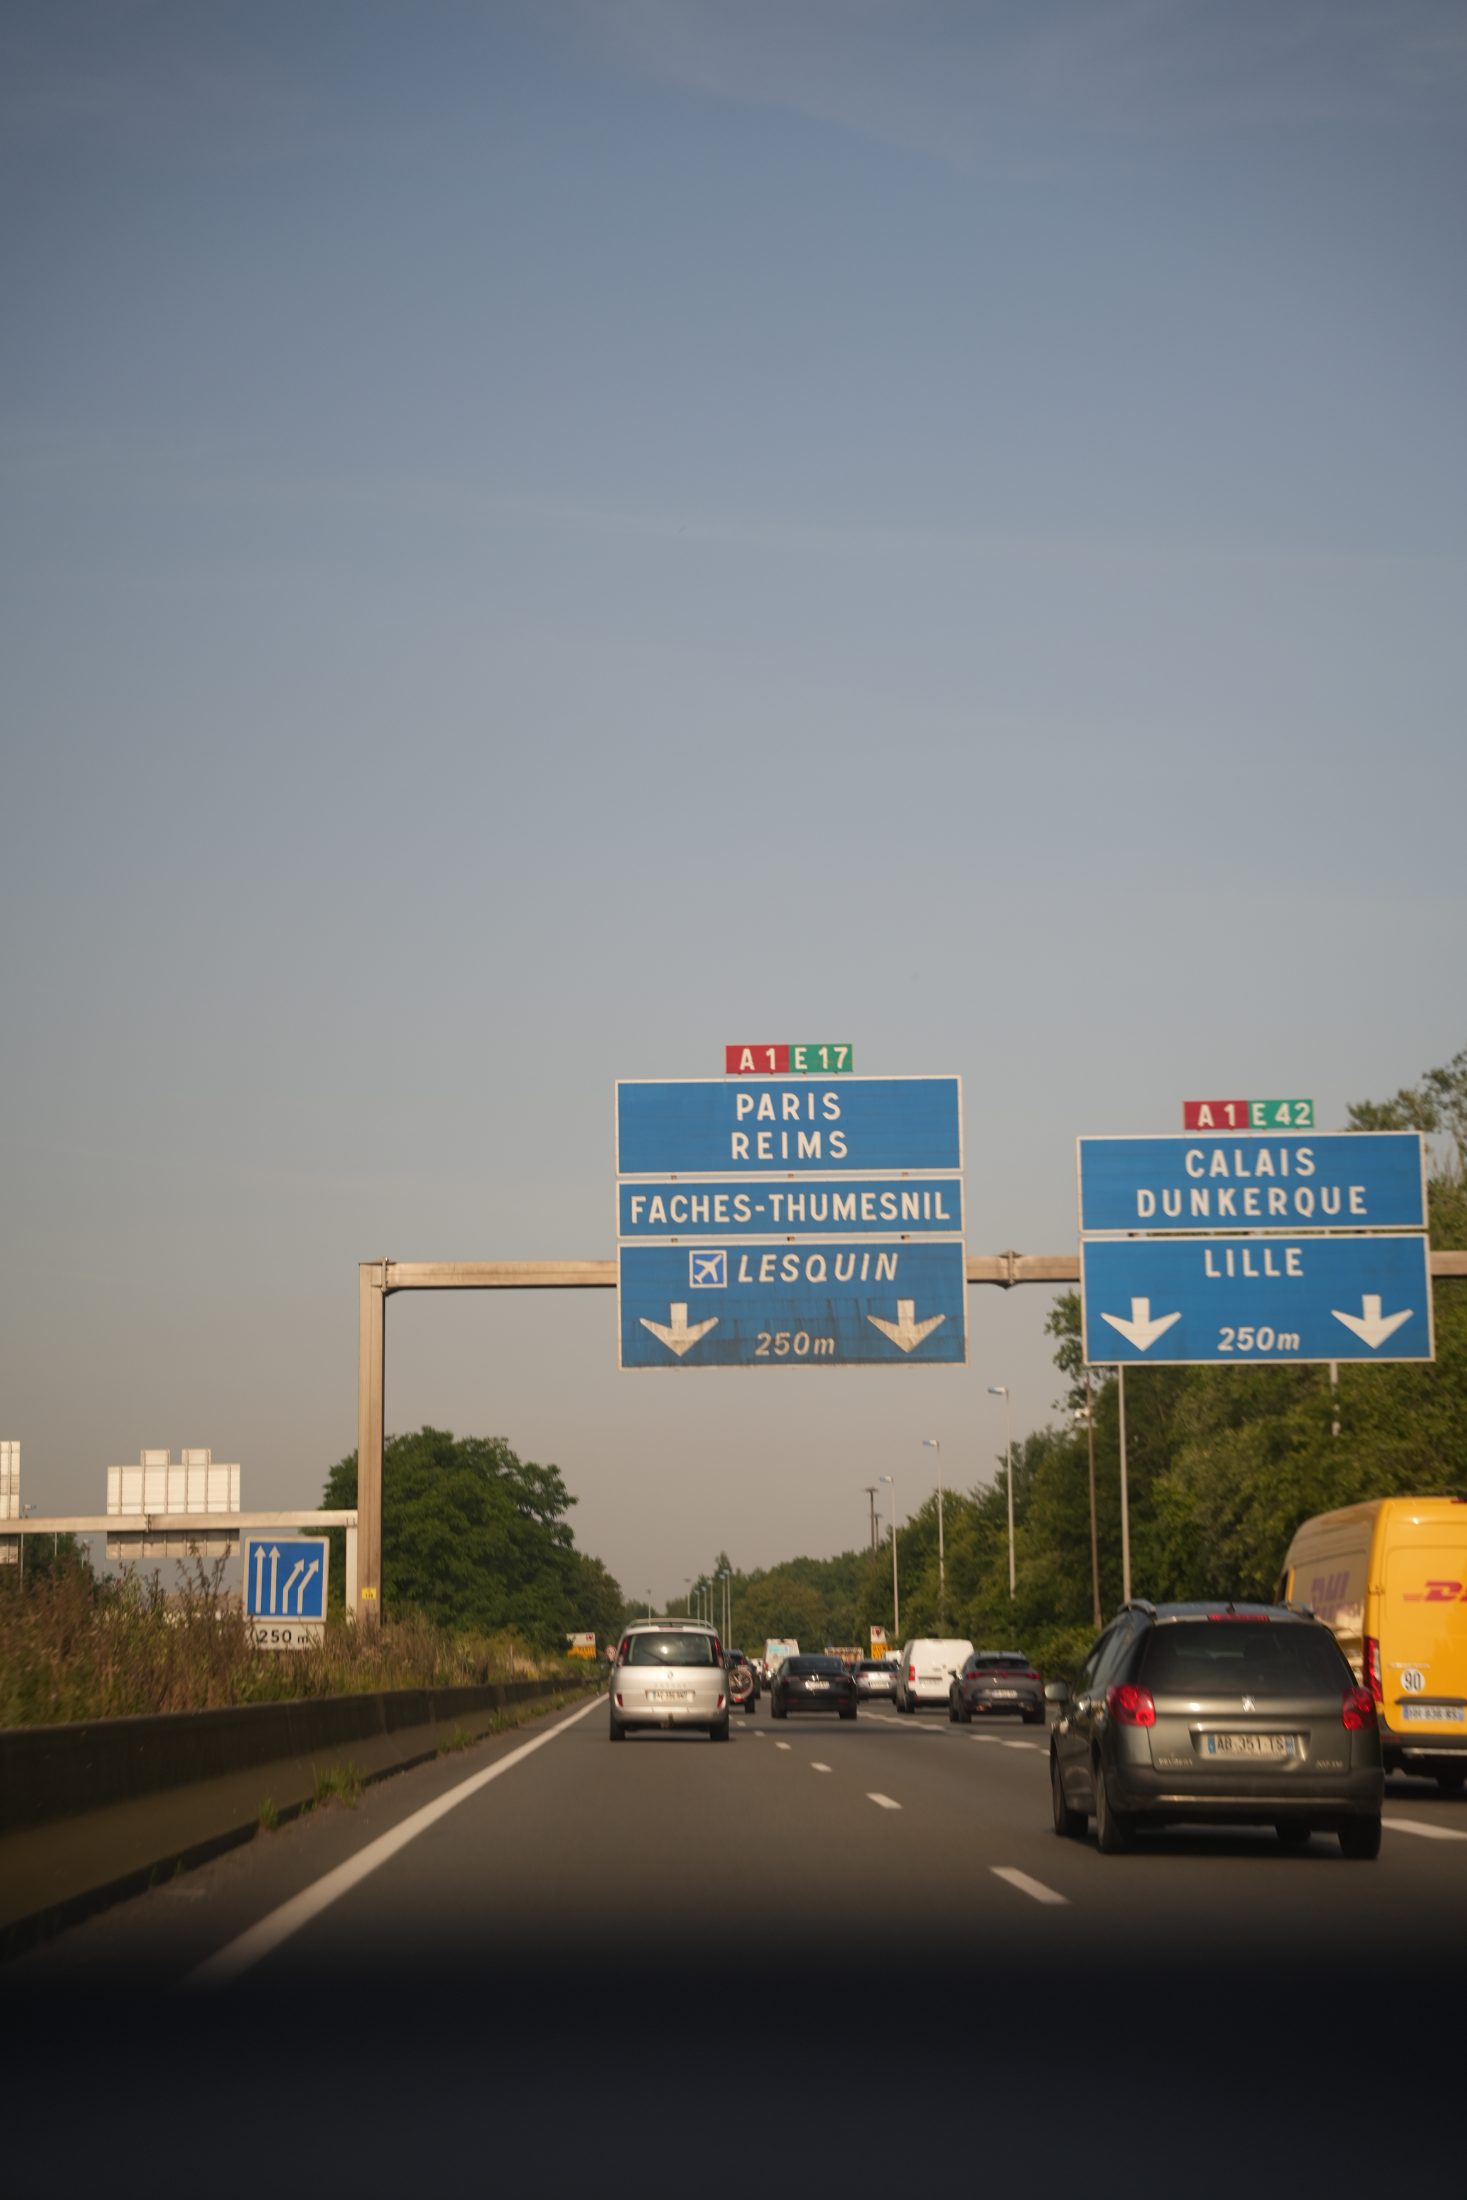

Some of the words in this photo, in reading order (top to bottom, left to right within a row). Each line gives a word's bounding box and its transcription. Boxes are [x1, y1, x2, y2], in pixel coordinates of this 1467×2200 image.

[795, 1048, 807, 1069] E
[819, 1047, 848, 1069] 17
[736, 1092, 841, 1121] PARIS
[1252, 1103, 1266, 1125] E
[1275, 1102, 1311, 1125] 42
[731, 1131, 848, 1160] REIMS
[1185, 1148, 1315, 1178] CALAIS
[631, 1192, 950, 1224] FACHES-THUMESNIL
[1137, 1186, 1367, 1218] DUNKERQUE
[738, 1253, 898, 1283] LESQUIN
[1204, 1248, 1304, 1278] LILLE
[755, 1332, 835, 1356] 250m
[1217, 1326, 1300, 1351] 250m
[259, 1630, 292, 1643] 250
[1405, 1671, 1421, 1690] 90
